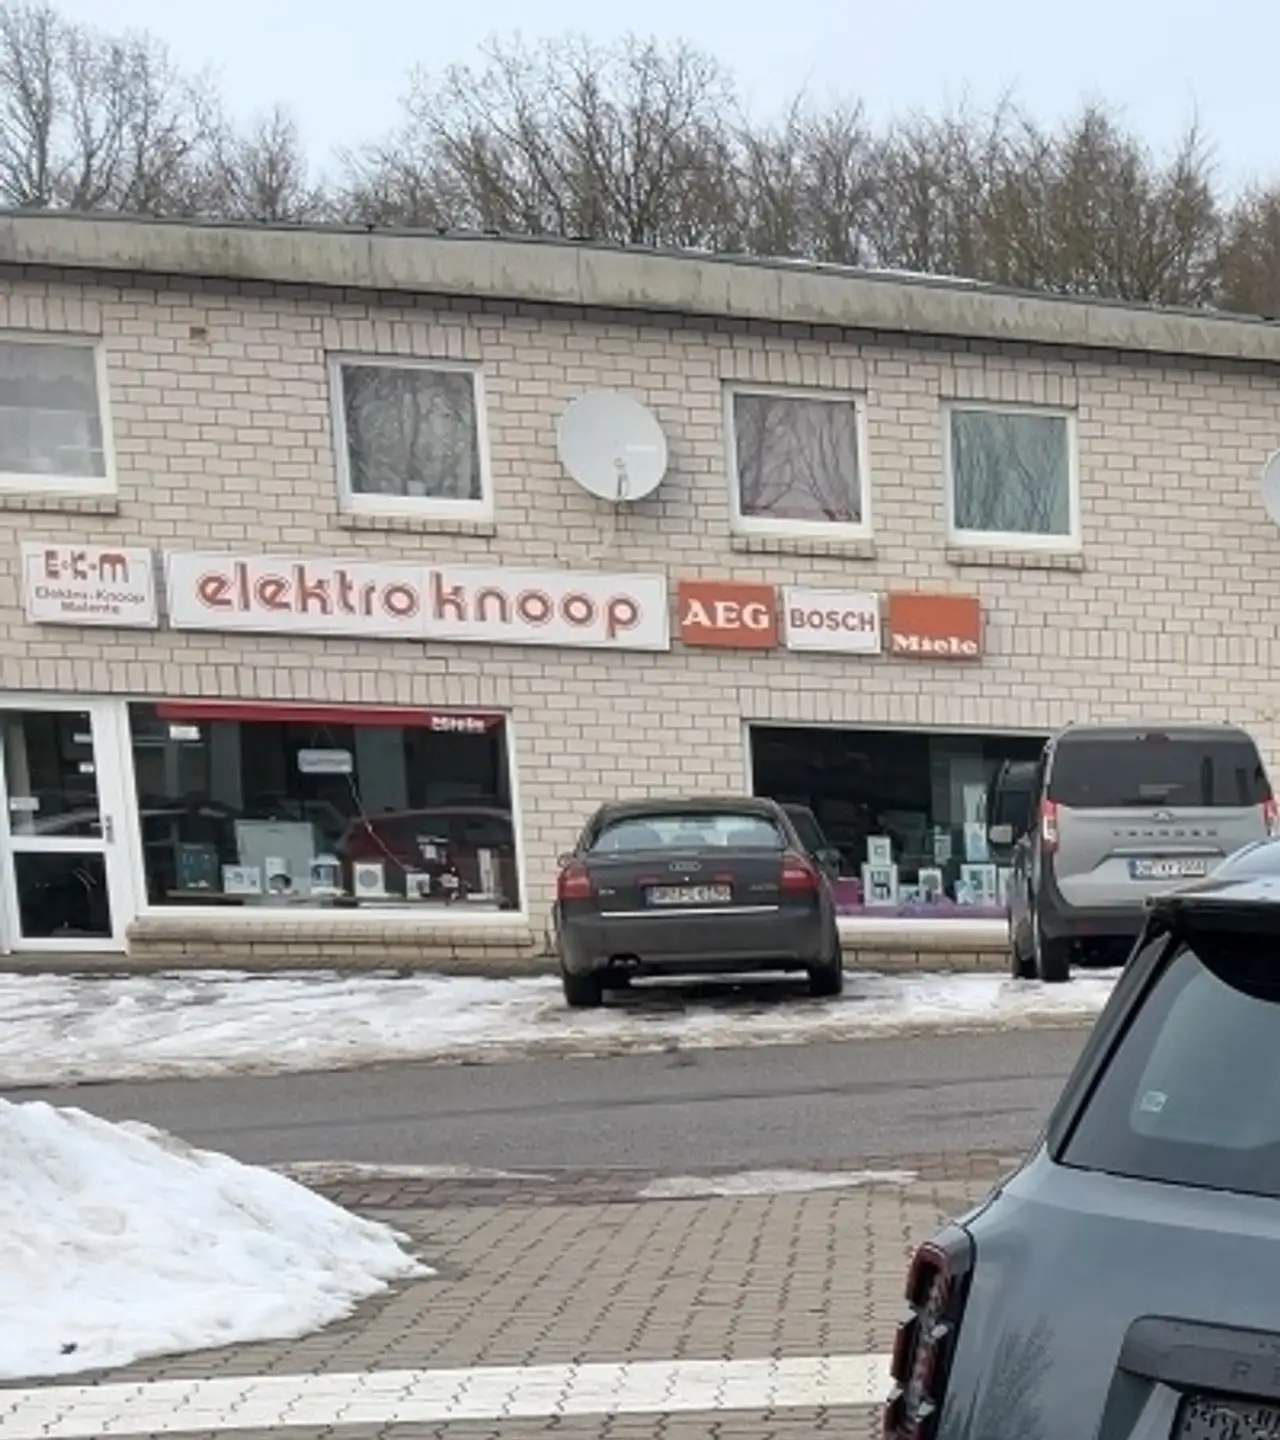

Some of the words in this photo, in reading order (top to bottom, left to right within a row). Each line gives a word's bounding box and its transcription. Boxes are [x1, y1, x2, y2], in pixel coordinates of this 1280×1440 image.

[432, 570, 640, 641] knoop
[682, 598, 770, 630] AEG
[790, 607, 875, 633] BOSCH
[892, 632, 978, 655] Miele
